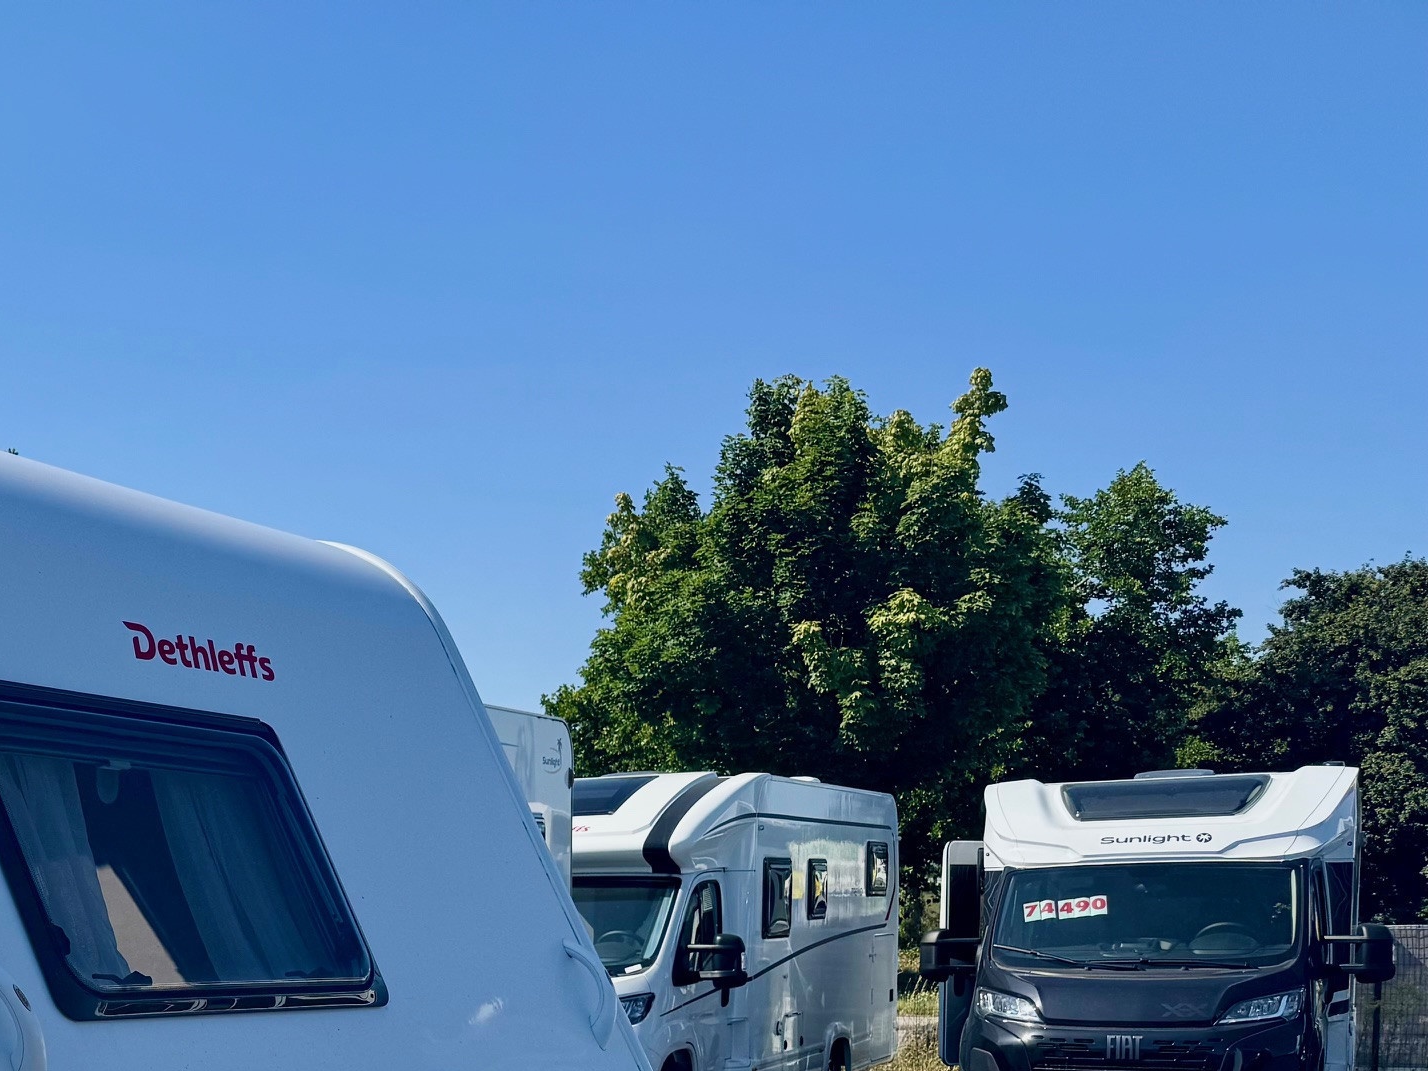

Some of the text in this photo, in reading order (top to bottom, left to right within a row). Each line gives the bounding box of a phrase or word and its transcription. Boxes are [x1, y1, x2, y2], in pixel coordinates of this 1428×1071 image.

[122, 621, 275, 681] Dethleffs
[542, 756, 561, 768] Sunlight
[1100, 834, 1192, 845] Sunlight
[1024, 897, 1107, 918] 74490
[1106, 1034, 1144, 1060] FIAT
